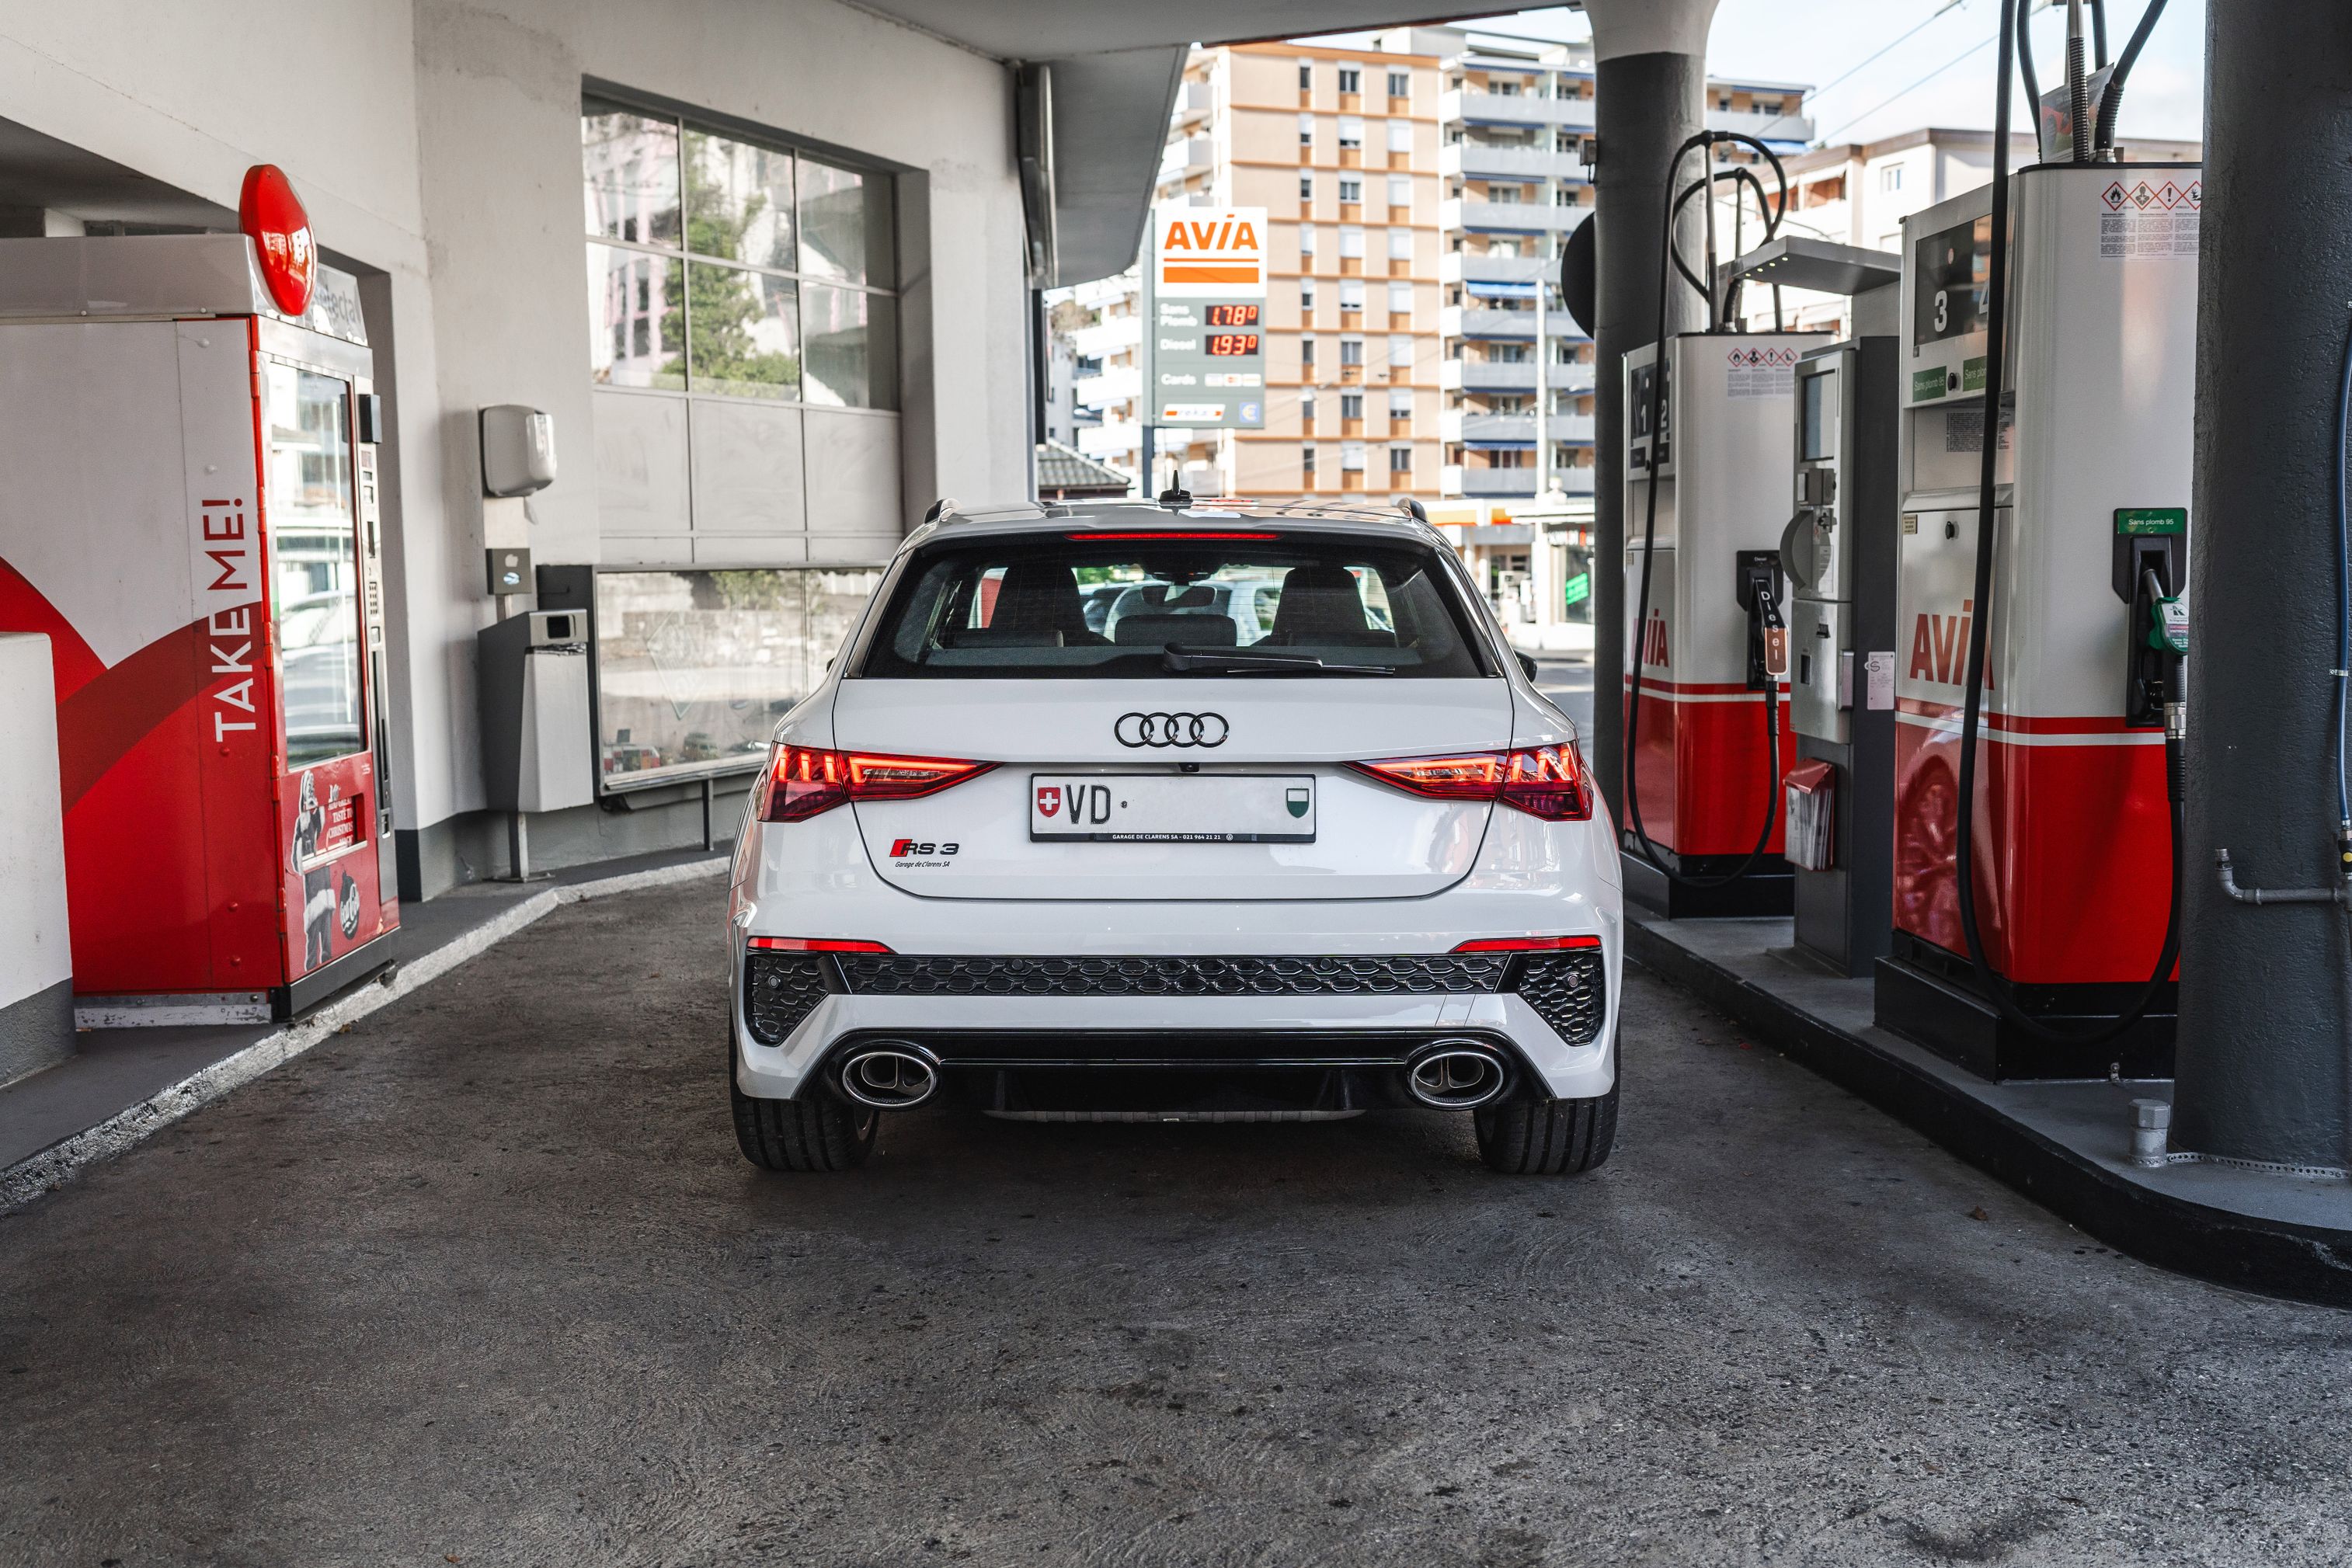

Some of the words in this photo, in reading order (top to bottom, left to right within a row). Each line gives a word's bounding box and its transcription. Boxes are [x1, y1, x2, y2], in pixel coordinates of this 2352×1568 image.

[1934, 290, 1948, 332] 3
[1641, 404, 1647, 433] 1
[1661, 398, 1668, 428] 2
[202, 498, 248, 590] ME!
[1760, 591, 1780, 660] Diesel
[208, 607, 256, 742] TAKE
[898, 843, 937, 855] RS
[940, 843, 959, 855] 3
